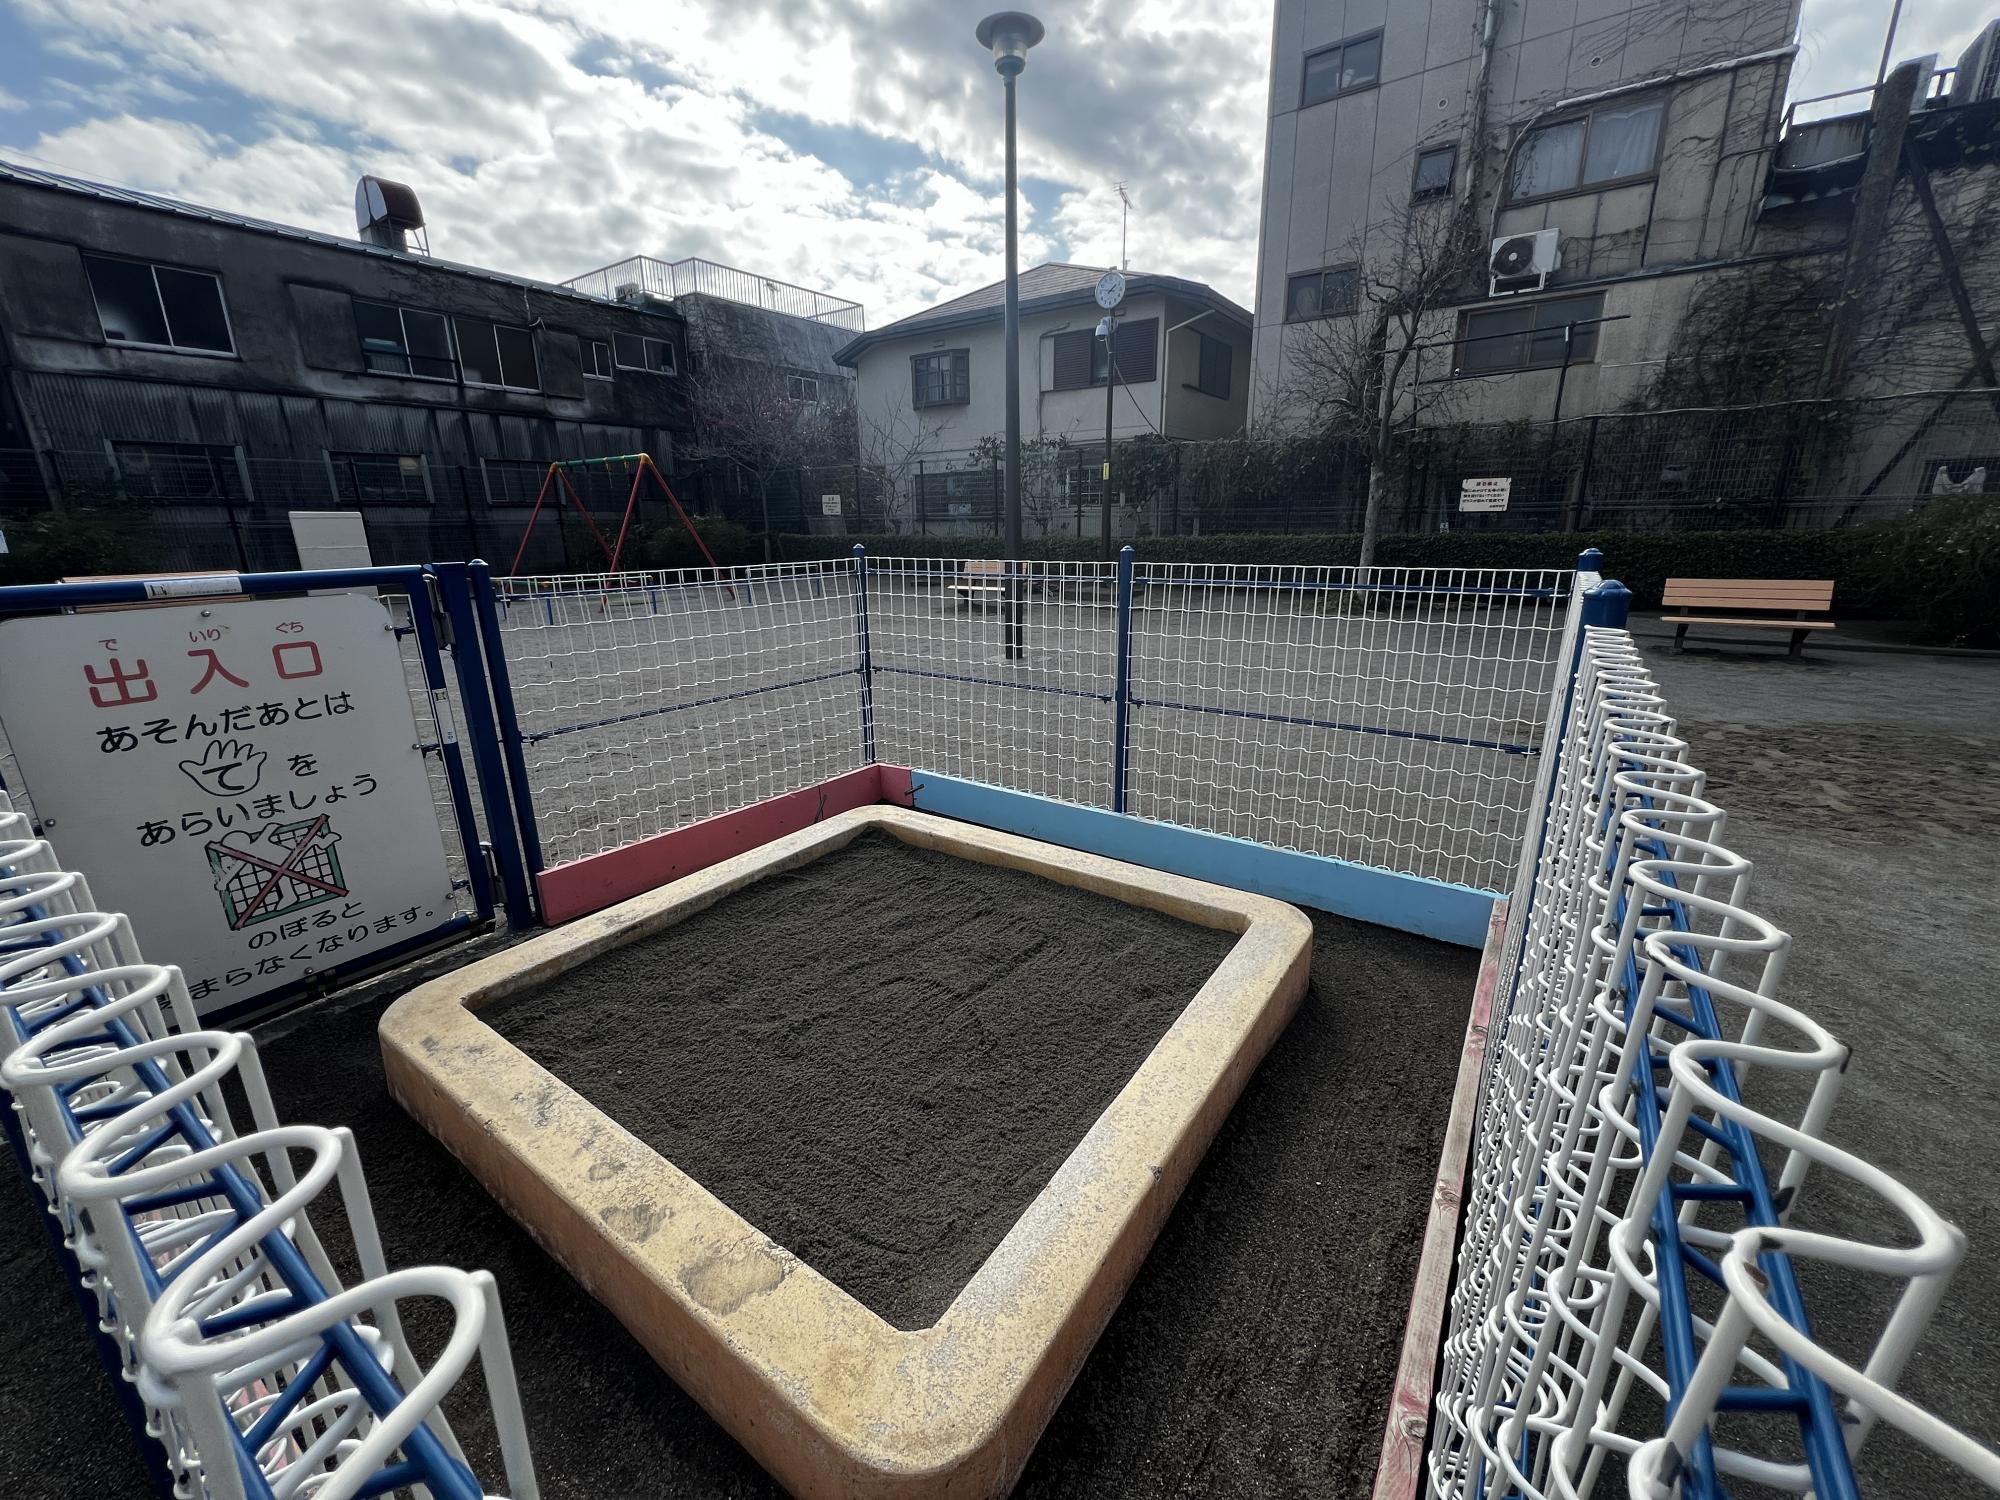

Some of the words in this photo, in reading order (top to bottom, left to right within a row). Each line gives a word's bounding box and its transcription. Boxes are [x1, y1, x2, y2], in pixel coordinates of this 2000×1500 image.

[96, 691, 355, 753] あそんだあとは
[287, 753, 318, 777] を
[137, 773, 378, 847] あらいましょう
[248, 902, 365, 950] のぼると
[157, 907, 434, 1010] まらなくなります。
